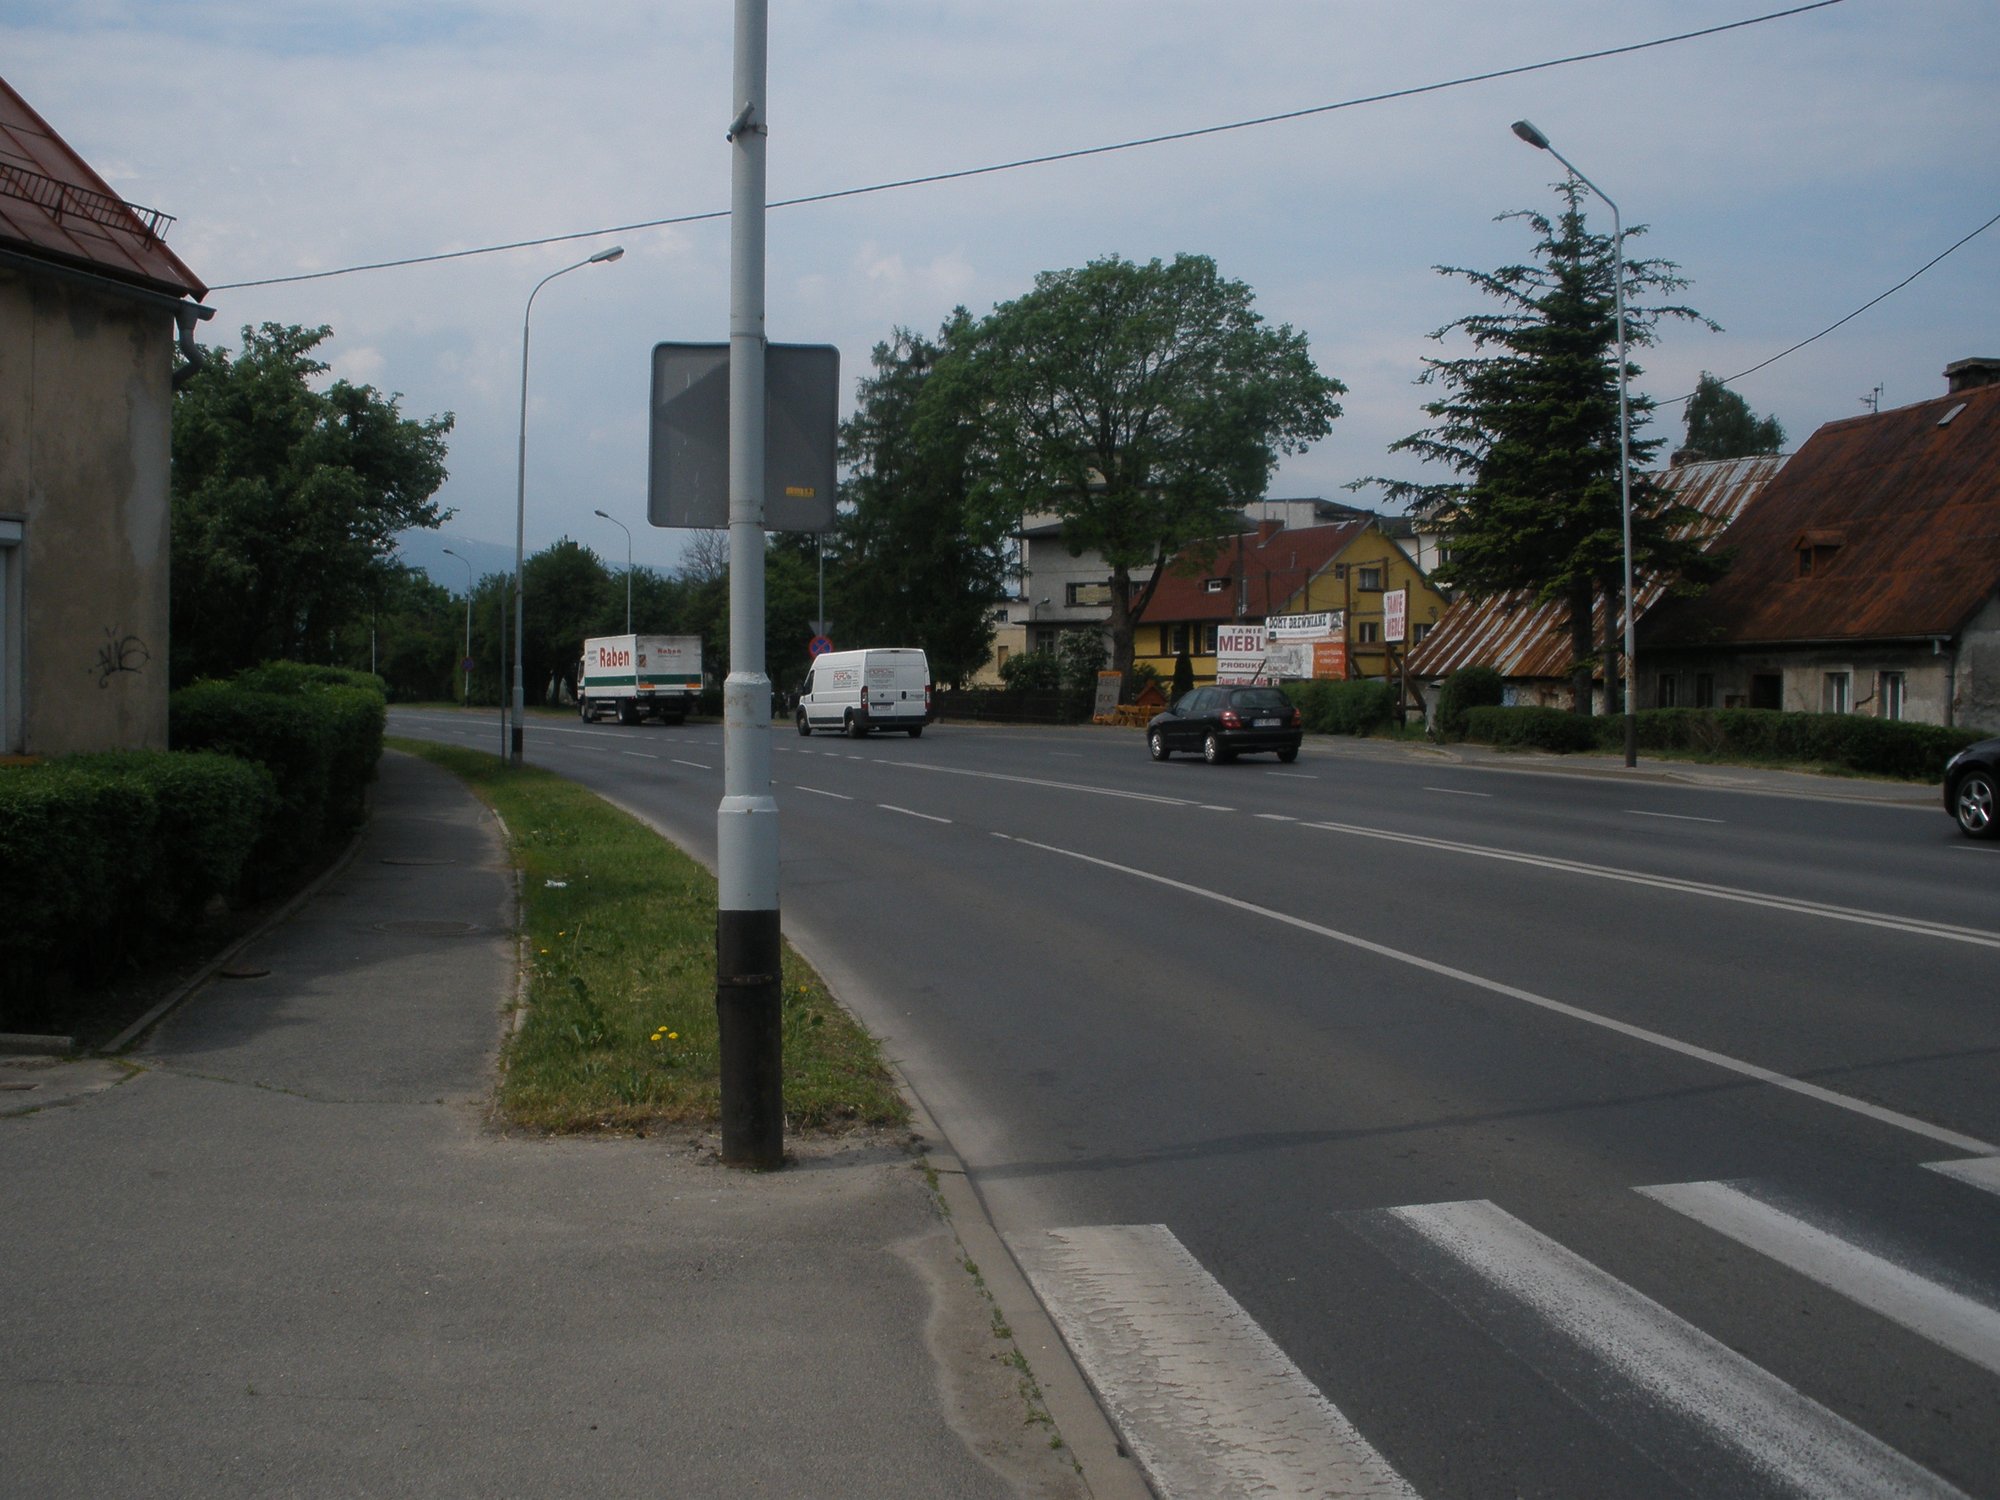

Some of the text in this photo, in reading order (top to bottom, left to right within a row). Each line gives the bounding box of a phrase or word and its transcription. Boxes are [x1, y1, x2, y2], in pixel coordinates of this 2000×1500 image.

[1269, 617, 1288, 629] DOMY
[1219, 635, 1264, 652] MEBL
[600, 646, 630, 667] Raben
